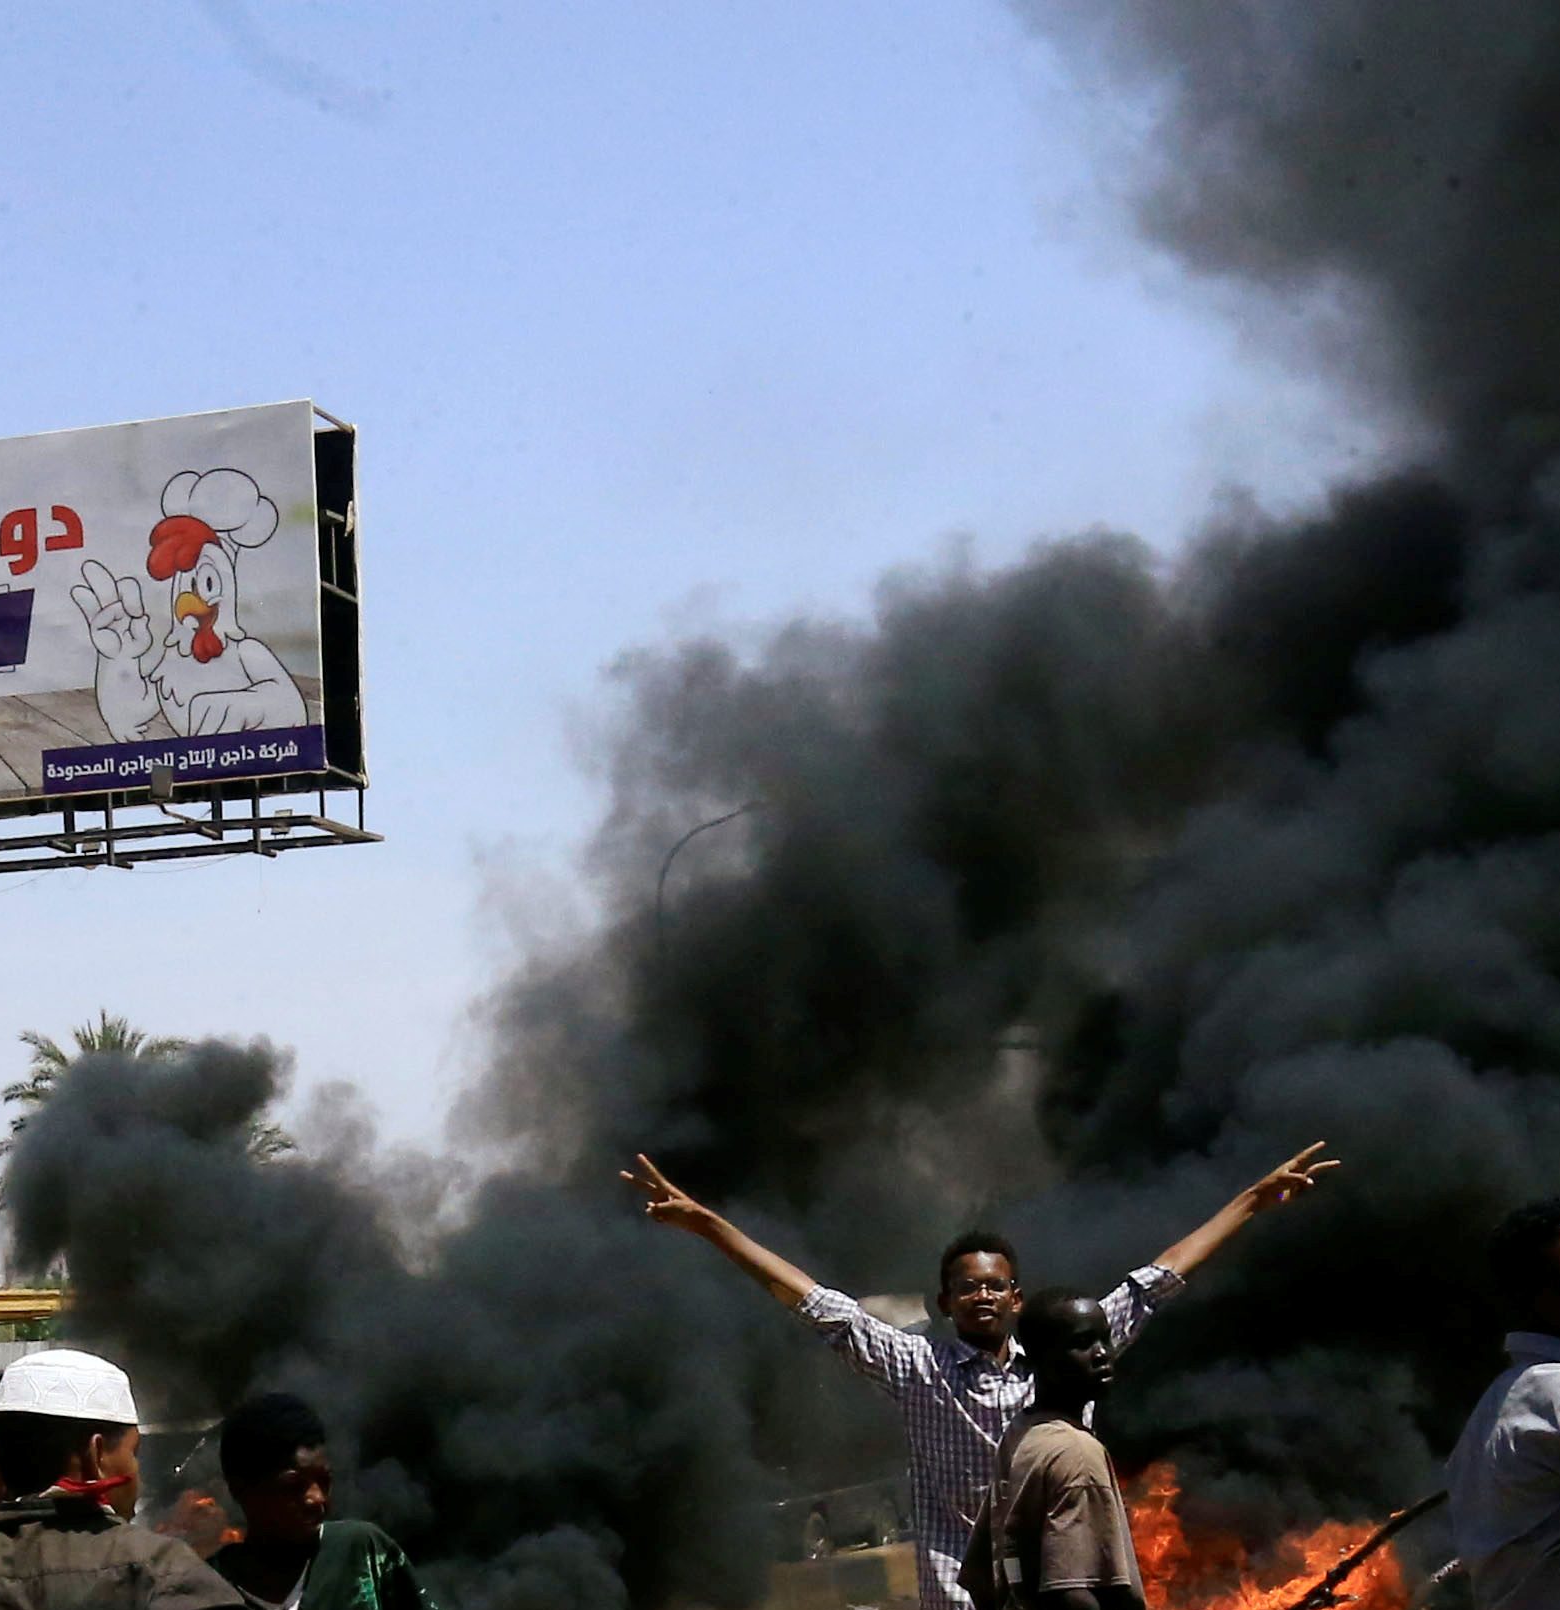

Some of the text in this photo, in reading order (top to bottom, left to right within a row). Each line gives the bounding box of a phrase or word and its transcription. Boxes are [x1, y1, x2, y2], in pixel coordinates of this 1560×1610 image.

[178, 748, 216, 770] لإنتاج
[220, 745, 255, 766] داجن
[259, 740, 299, 762] شركة
[46, 758, 114, 781] المحدودة
